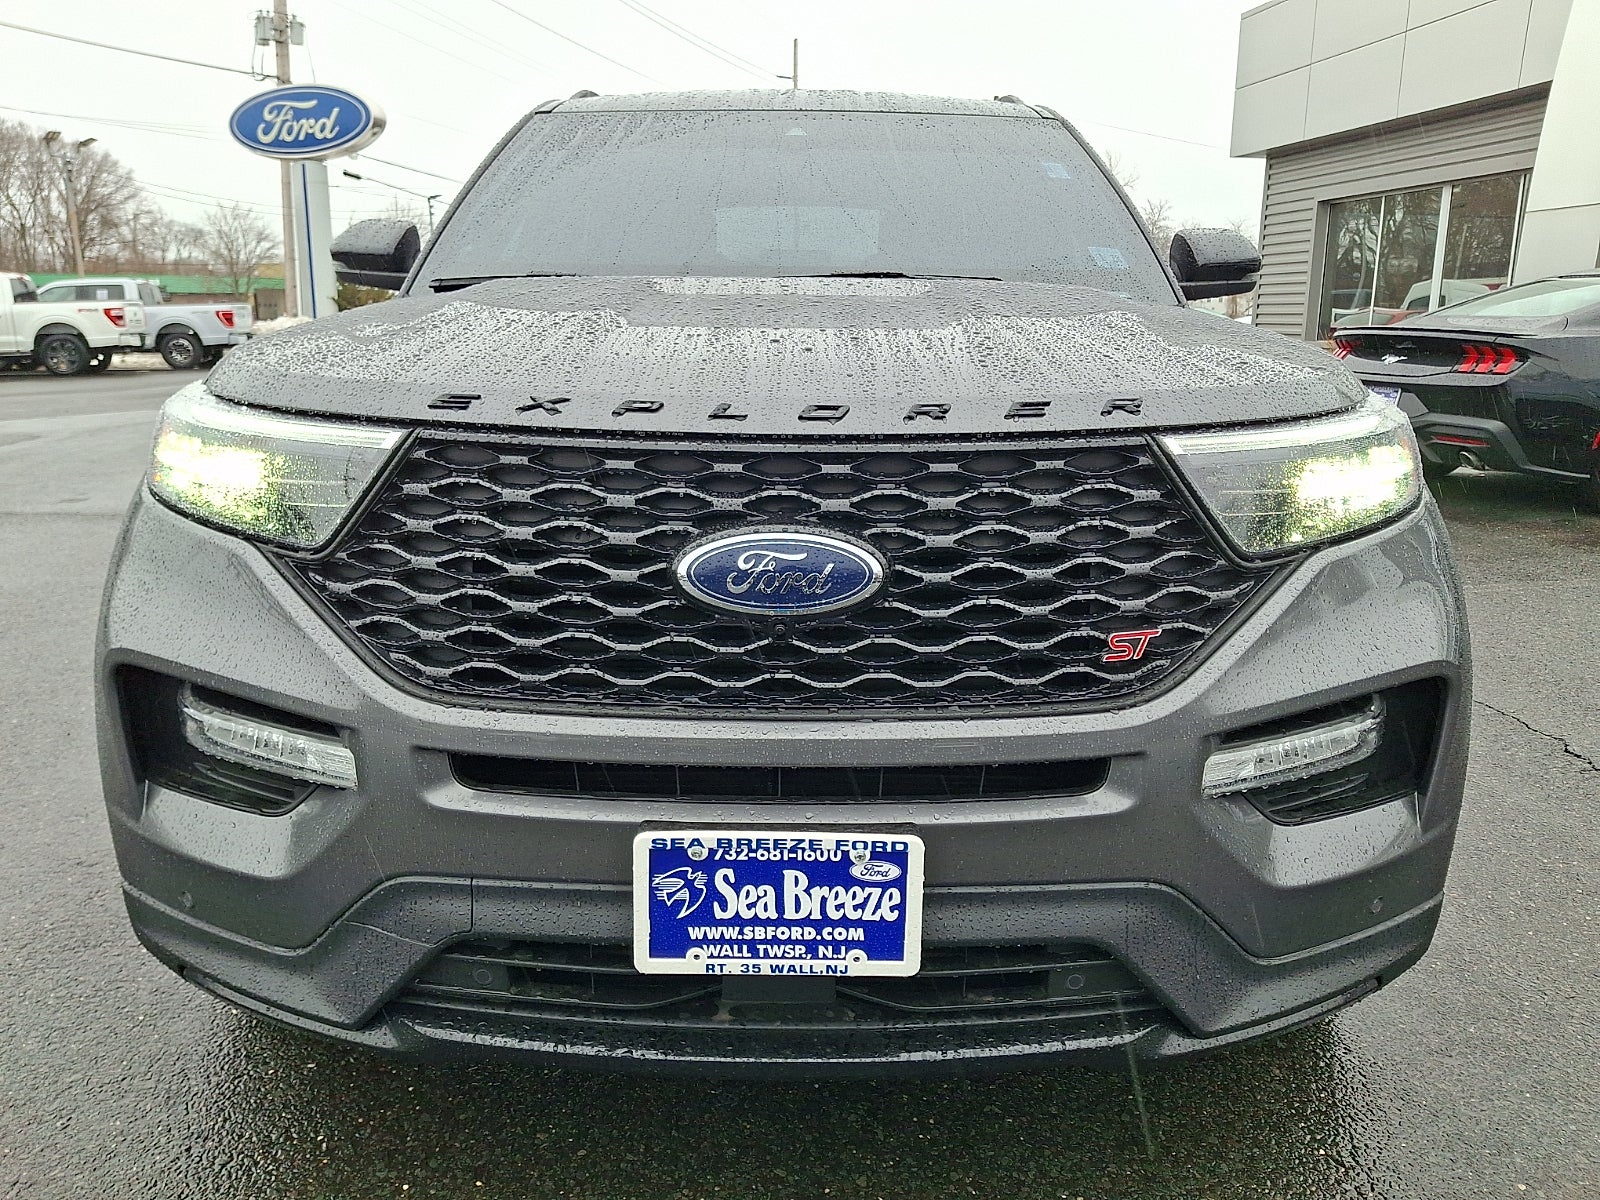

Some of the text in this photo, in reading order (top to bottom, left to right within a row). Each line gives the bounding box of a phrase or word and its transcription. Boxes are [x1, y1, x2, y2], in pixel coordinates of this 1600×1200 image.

[256, 99, 340, 144] Ford
[427, 393, 1143, 424] EXPLORER
[726, 550, 835, 594] Ford
[1103, 629, 1163, 662] ST
[651, 838, 909, 852] SEA BREEZE FORD
[713, 848, 842, 862] 732-681-1600
[859, 863, 891, 879] Ford
[713, 868, 900, 922] Sea Breeze
[687, 926, 865, 941] WWW.SBFORD.COM
[702, 944, 752, 958] WALL
[705, 963, 732, 974] RT.
[740, 963, 762, 974] 35
